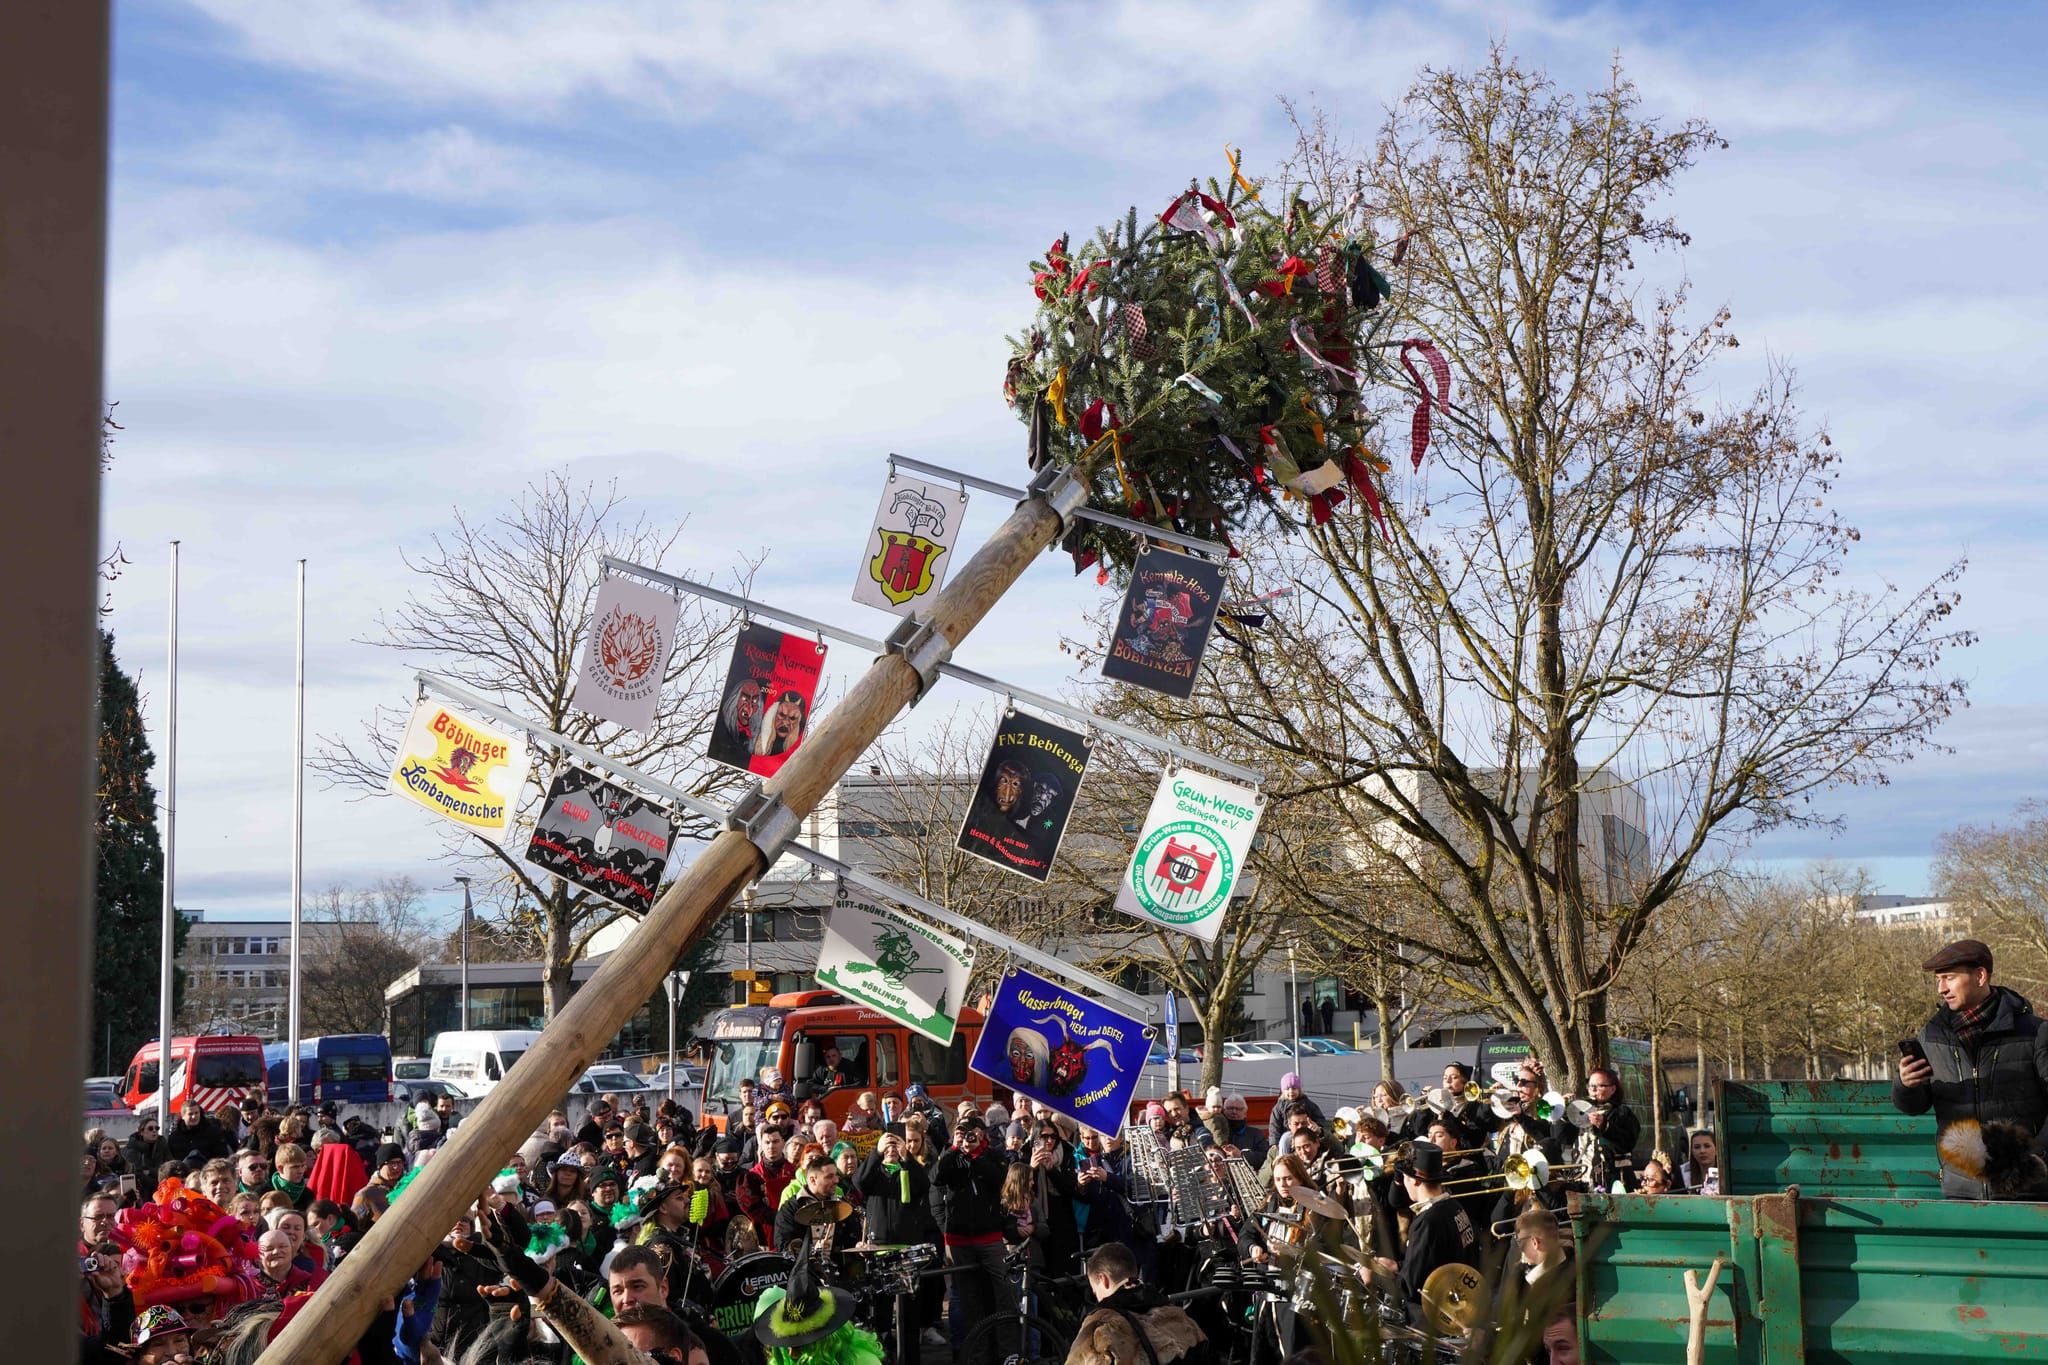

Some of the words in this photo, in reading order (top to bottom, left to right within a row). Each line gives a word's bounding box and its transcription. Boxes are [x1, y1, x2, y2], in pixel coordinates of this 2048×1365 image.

[1139, 569, 1211, 604] Kemmla-Hexa
[780, 655, 817, 676] Narren
[588, 665, 654, 701] GEISCHTERHEXE
[433, 712, 506, 762] Böblinger
[999, 733, 1025, 747] FNZ
[1028, 734, 1084, 774] Beblenga
[400, 760, 503, 819] Lombamenscher
[617, 819, 667, 852] SCHLOTZER
[1142, 824, 1192, 852] Grün-Weiss
[1194, 824, 1230, 860] Böblingen
[836, 899, 886, 917] GIFT-GRÜNE
[887, 912, 970, 968] SCHLOSSBERG-HEXEN
[861, 980, 908, 1007] BÖBLINGEN
[1069, 1021, 1087, 1036] HEXA
[1488, 1045, 1530, 1055] HSM-REN
[1074, 1079, 1118, 1108] Böblingen
[714, 1300, 754, 1329] GRÜN
